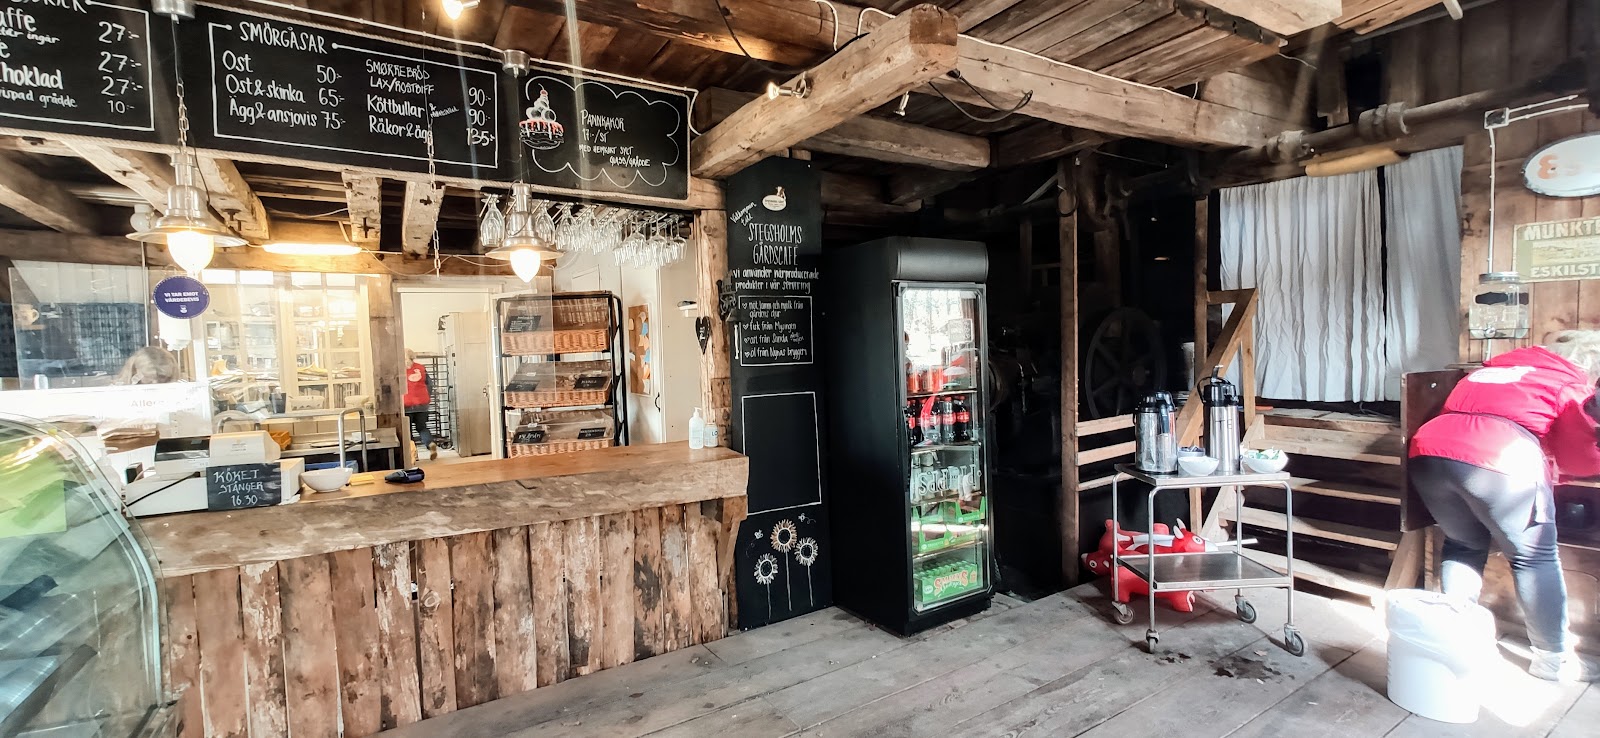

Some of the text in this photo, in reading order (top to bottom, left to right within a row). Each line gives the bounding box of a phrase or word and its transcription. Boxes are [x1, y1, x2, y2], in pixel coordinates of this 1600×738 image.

[239, 21, 328, 55] SMÖRGÅSAR
[222, 50, 254, 72] Ost
[367, 93, 426, 119] Köttbullar
[748, 222, 803, 244] STEGSHOLMS
[213, 467, 260, 484] KÖKET
